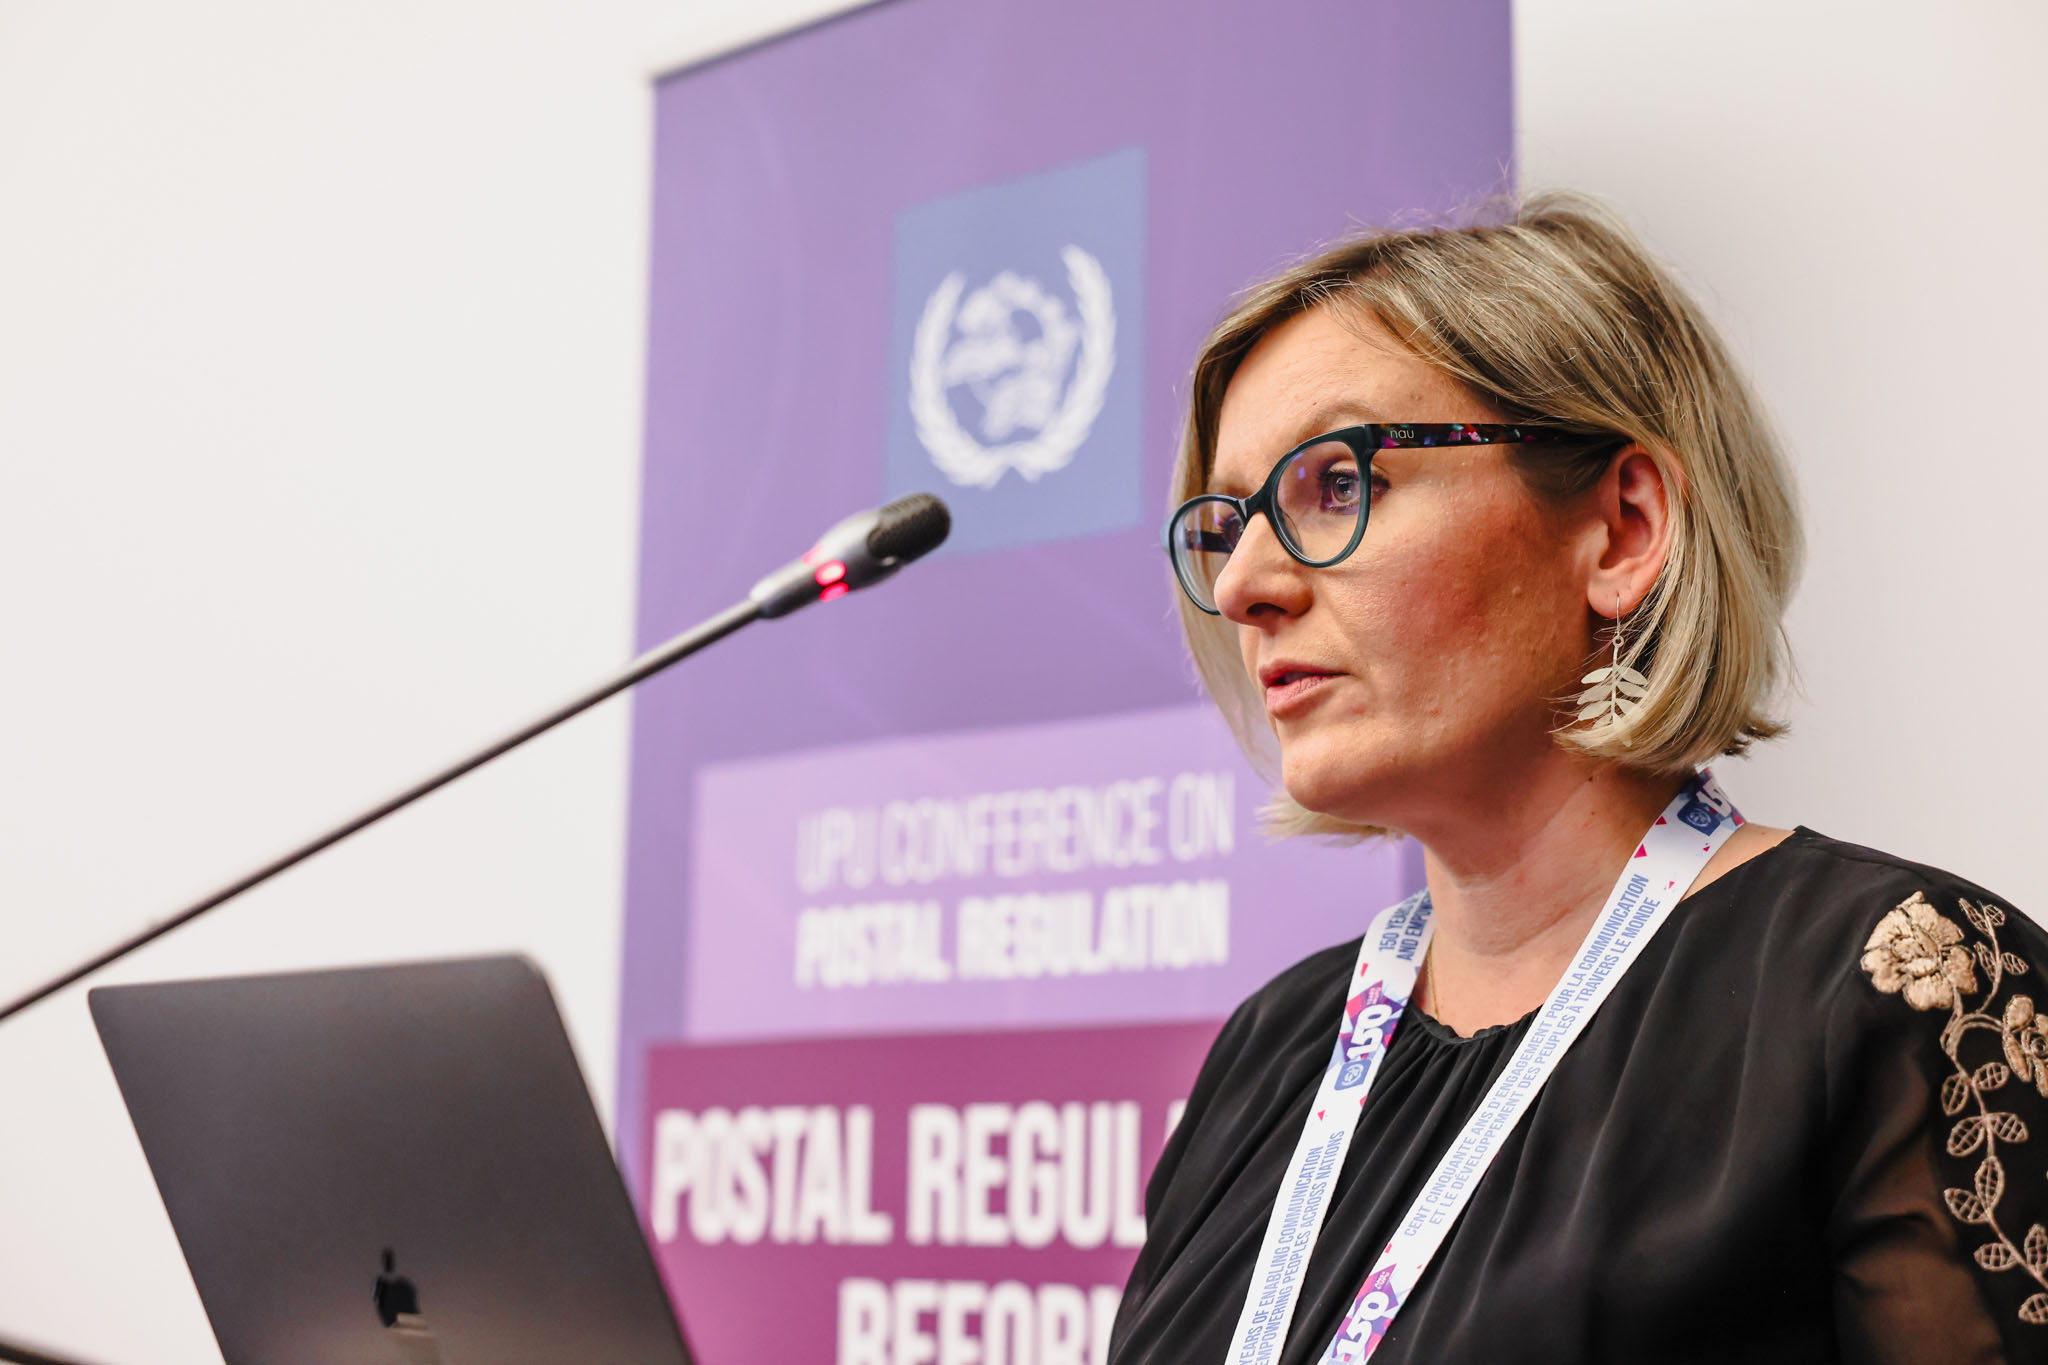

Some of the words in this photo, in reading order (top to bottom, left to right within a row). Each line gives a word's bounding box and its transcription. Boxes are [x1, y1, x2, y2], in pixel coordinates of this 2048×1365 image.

[1389, 429, 1415, 439] nau
[880, 776, 1166, 887] CONFERENCE
[1168, 771, 1236, 863] ON
[795, 898, 953, 989] POSTAL
[957, 878, 1230, 982] REGULATION
[1378, 932, 1399, 952] 150
[1627, 897, 1661, 939] MONDE
[1396, 938, 1419, 961] AND
[1610, 937, 1632, 955] LE
[1574, 953, 1620, 1004] TRAVERS
[1346, 1003, 1393, 1061] 150
[1568, 1001, 1584, 1015] À
[1404, 1206, 1430, 1237] CENT
[1425, 1137, 1477, 1206] CINQUANTE
[1470, 1112, 1494, 1136] ANS
[1488, 1020, 1553, 1111] D'ENGAGEMENT
[1546, 984, 1575, 1021] POUR
[1567, 967, 1587, 988] LA
[1578, 873, 1650, 971] COMMUNICATION
[1535, 1014, 1577, 1065] PEUPLES
[1517, 1066, 1541, 1090] DES
[1451, 1091, 1524, 1191] DÉVELOPPEMENT
[650, 1103, 894, 1246] POSTAL
[906, 1099, 1186, 1248] REGUL
[1279, 1146, 1324, 1243] COMMUNICATION
[1282, 1231, 1311, 1284] PEOPLES
[1300, 1181, 1328, 1229] ACROSS
[1319, 1130, 1345, 1181] NATIONS
[1429, 1210, 1446, 1225] ET
[1440, 1192, 1458, 1210] LE
[1259, 1248, 1290, 1307] ENABLING
[1252, 1310, 1269, 1324] OF
[1336, 1291, 1389, 1359] 150
